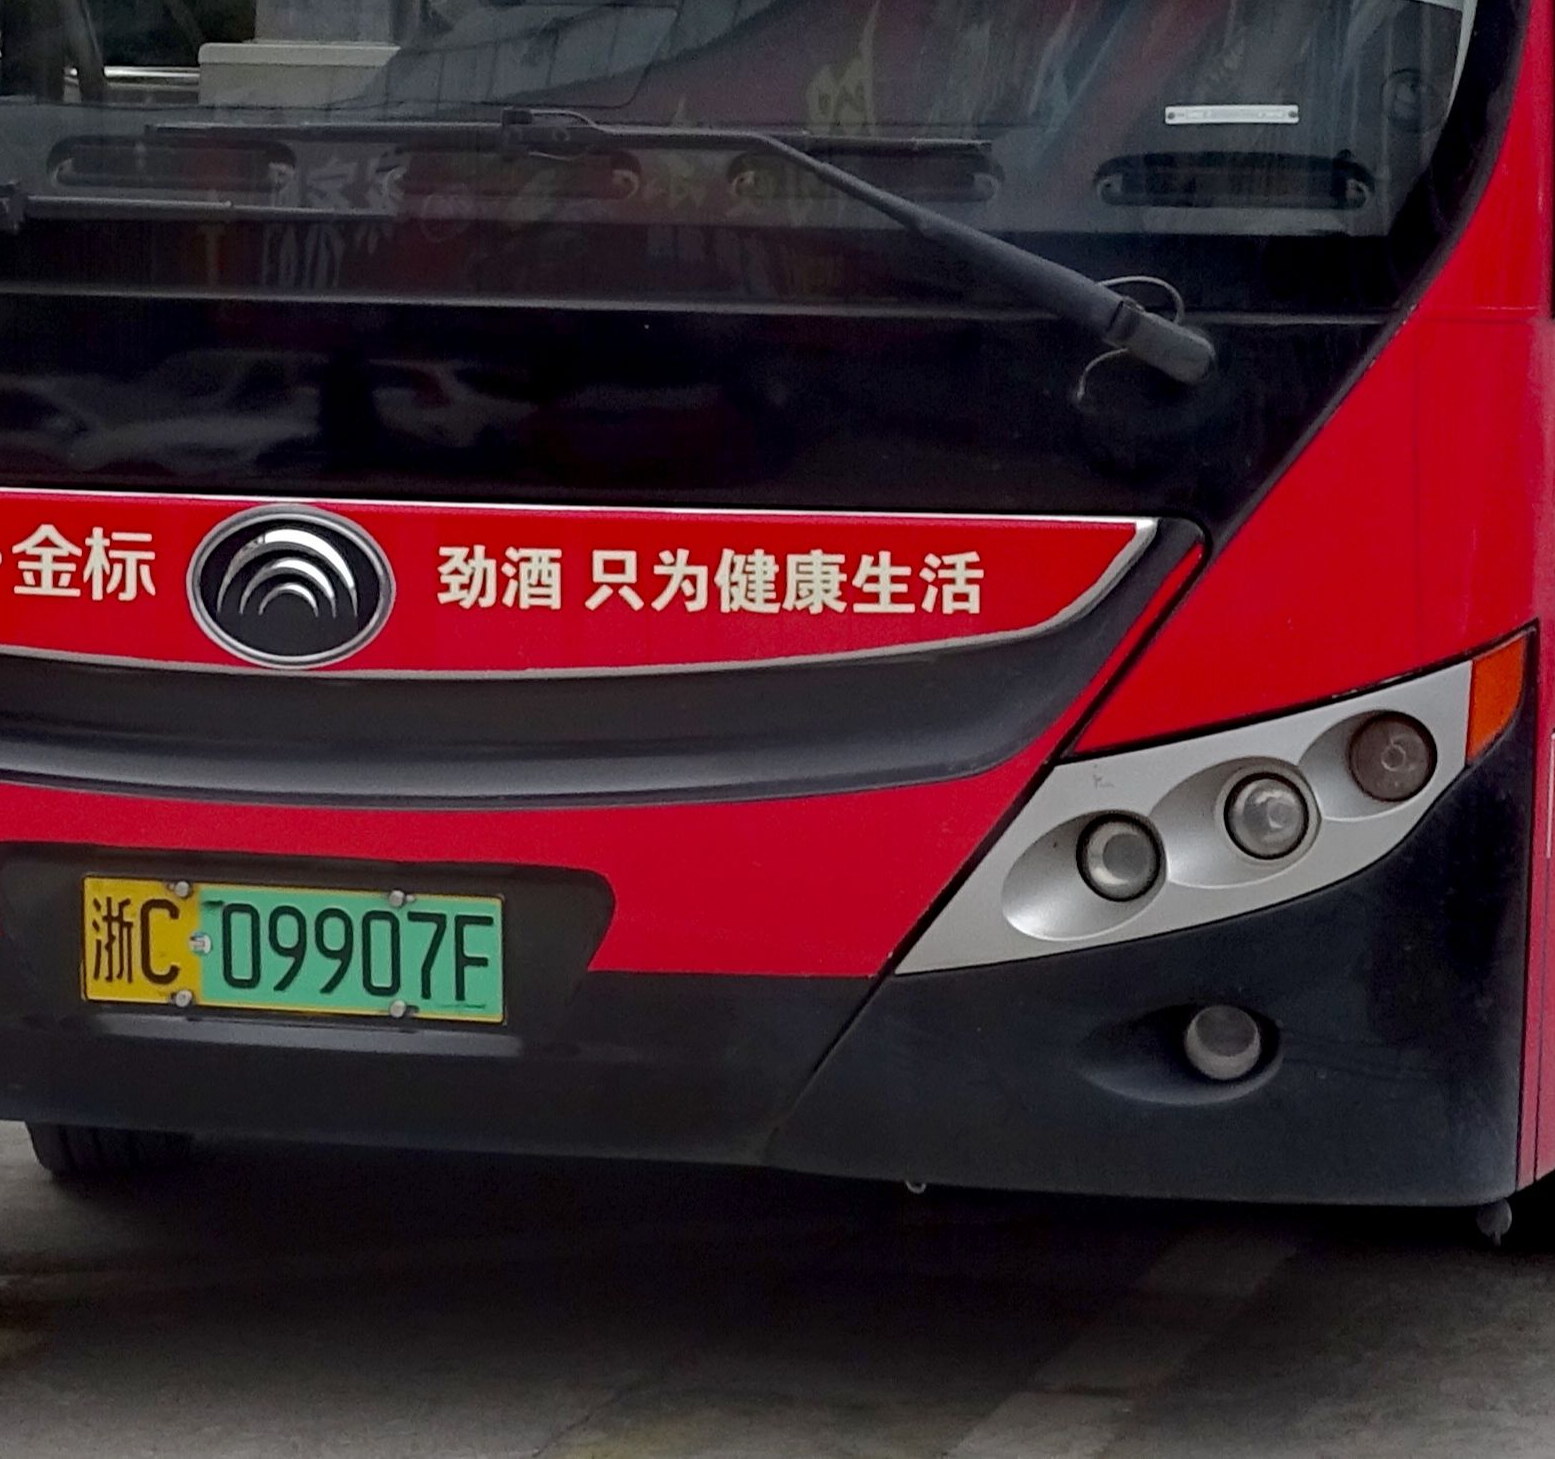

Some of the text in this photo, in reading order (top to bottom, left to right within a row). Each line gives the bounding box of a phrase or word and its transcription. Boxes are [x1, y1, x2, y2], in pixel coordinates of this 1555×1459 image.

[437, 545, 986, 616] 劲酒 只为健康生活
